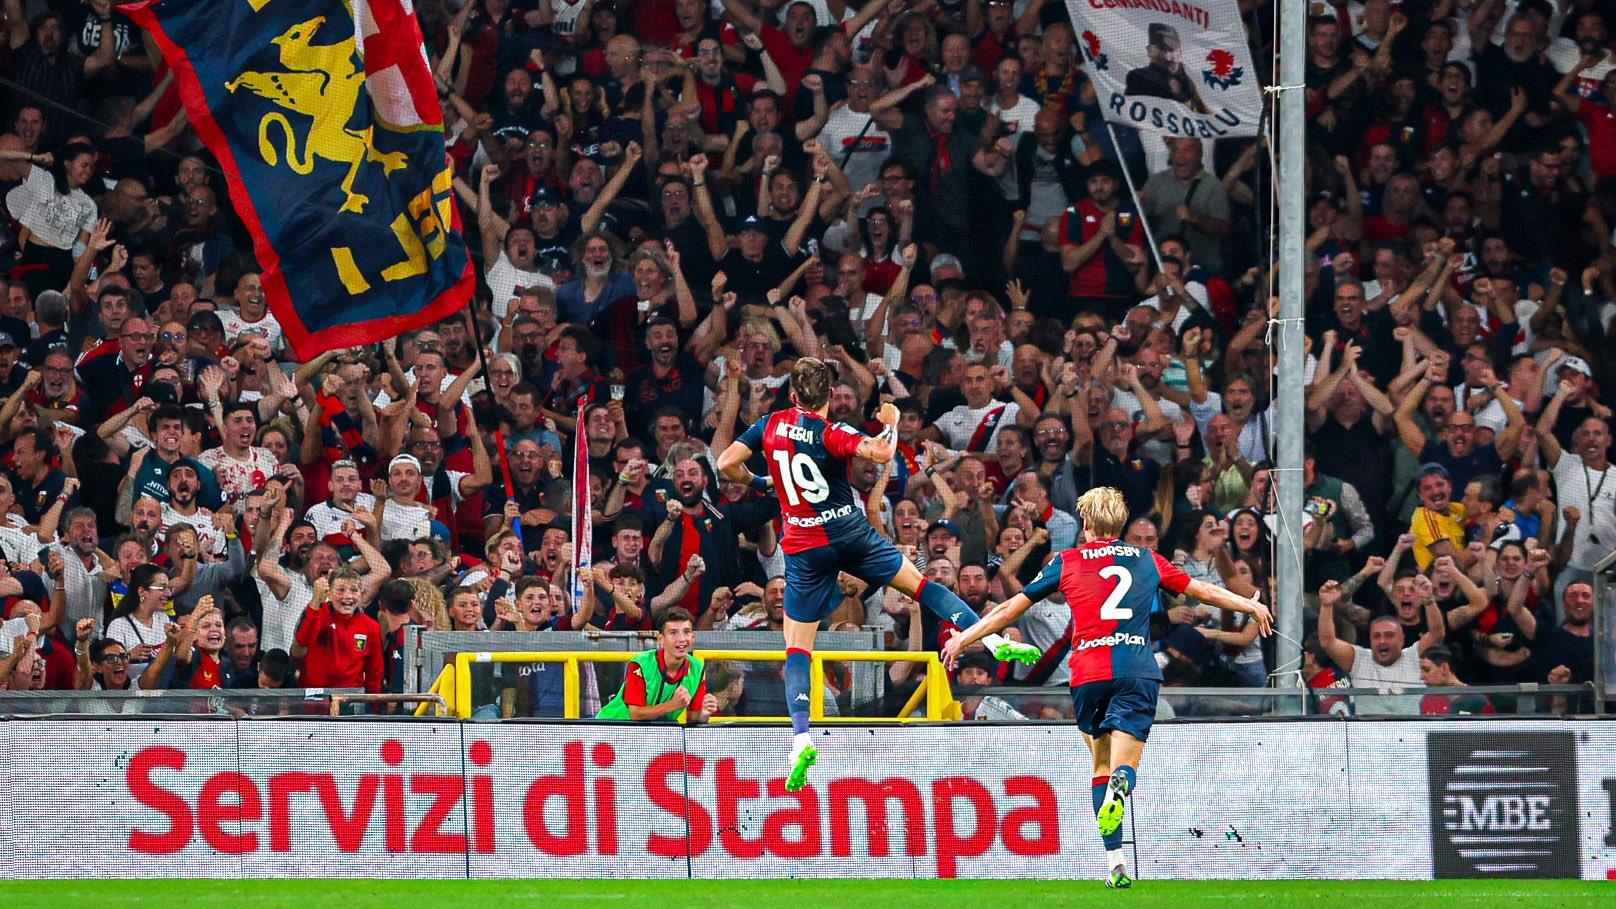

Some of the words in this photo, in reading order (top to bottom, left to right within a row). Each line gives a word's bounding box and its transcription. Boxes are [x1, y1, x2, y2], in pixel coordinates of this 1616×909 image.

[1110, 92, 1240, 138] ROSSOBLU
[772, 449, 830, 506] 19
[785, 504, 852, 527] easePlan
[1080, 545, 1140, 559] THORSBY
[1098, 565, 1133, 620] 2
[127, 740, 496, 855] Servizi
[525, 741, 618, 856] di
[645, 751, 1060, 878] Stampa
[1461, 795, 1553, 829] MBE
